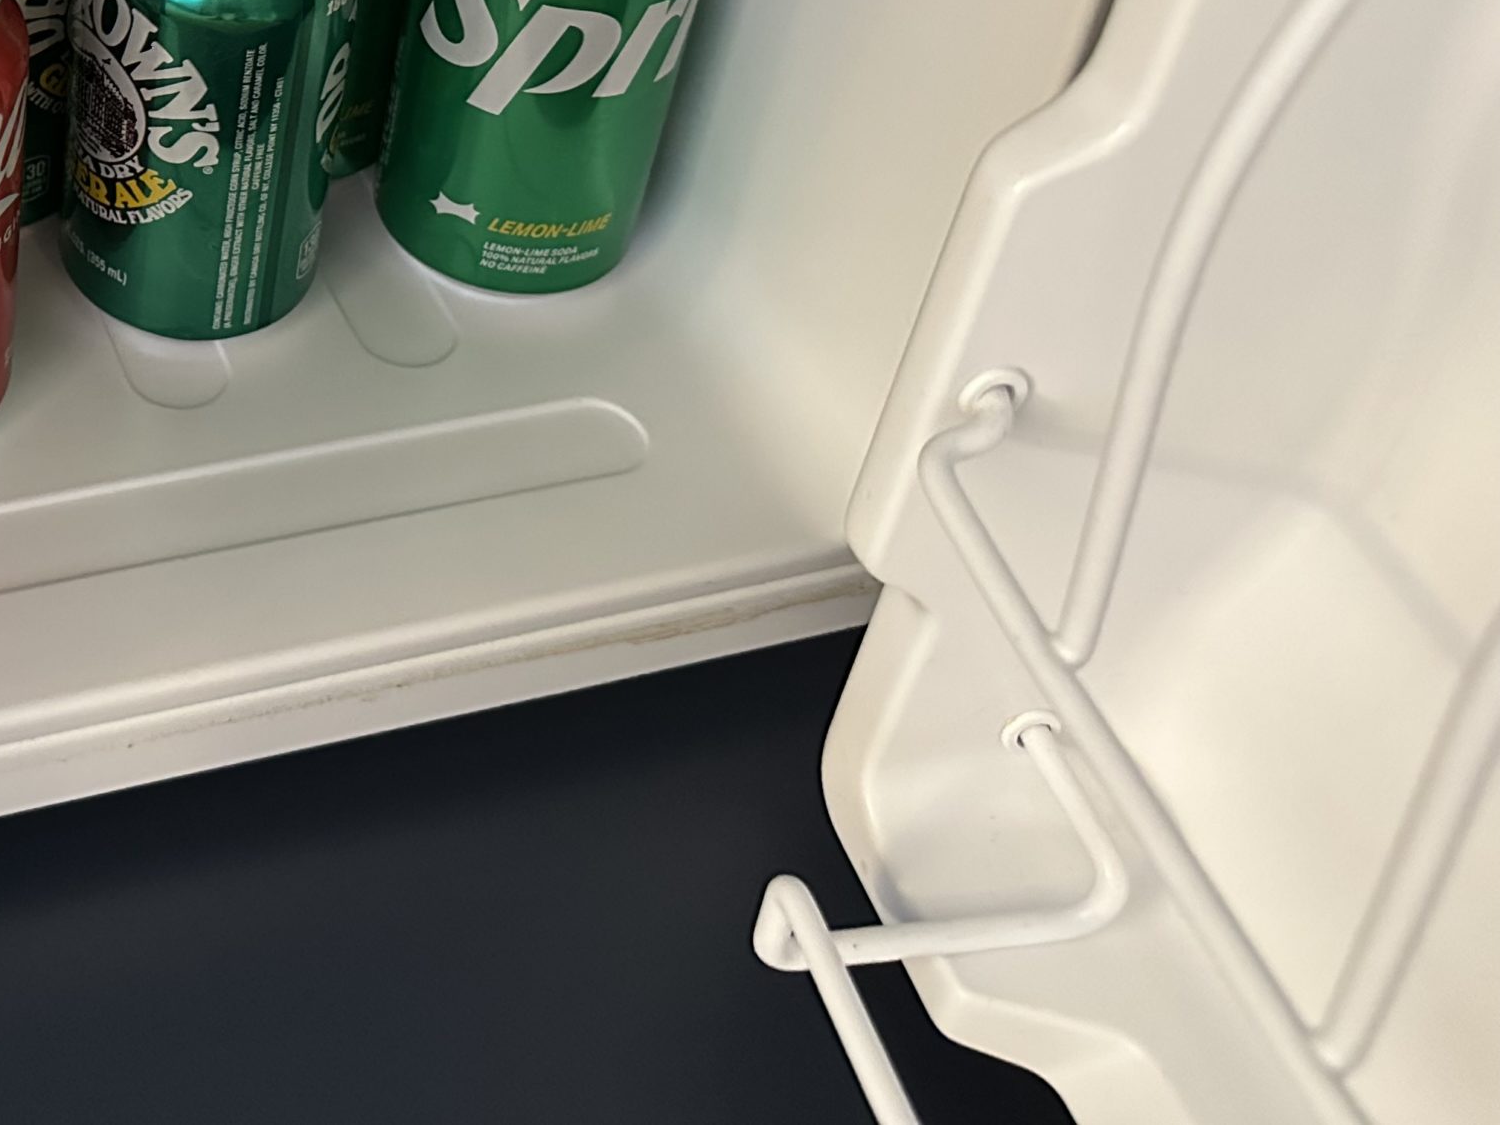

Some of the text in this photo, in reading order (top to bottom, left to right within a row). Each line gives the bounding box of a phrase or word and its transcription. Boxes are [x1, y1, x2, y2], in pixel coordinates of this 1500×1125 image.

[236, 129, 244, 148] CITRIC
[244, 49, 254, 83] BENZOATE
[249, 115, 257, 130] SALT
[253, 66, 263, 98] CARAMEL
[100, 155, 144, 179] DRY
[115, 169, 177, 209] ALE
[127, 188, 193, 225] FLAVORS
[487, 212, 612, 239] LEMON-LIME
[481, 249, 510, 263] 100%
[510, 256, 557, 266] NATURAL
[483, 241, 578, 257] LEMON-LIME SODA
[107, 266, 127, 287] mL)
[479, 258, 548, 274] NO CAFFEINE
